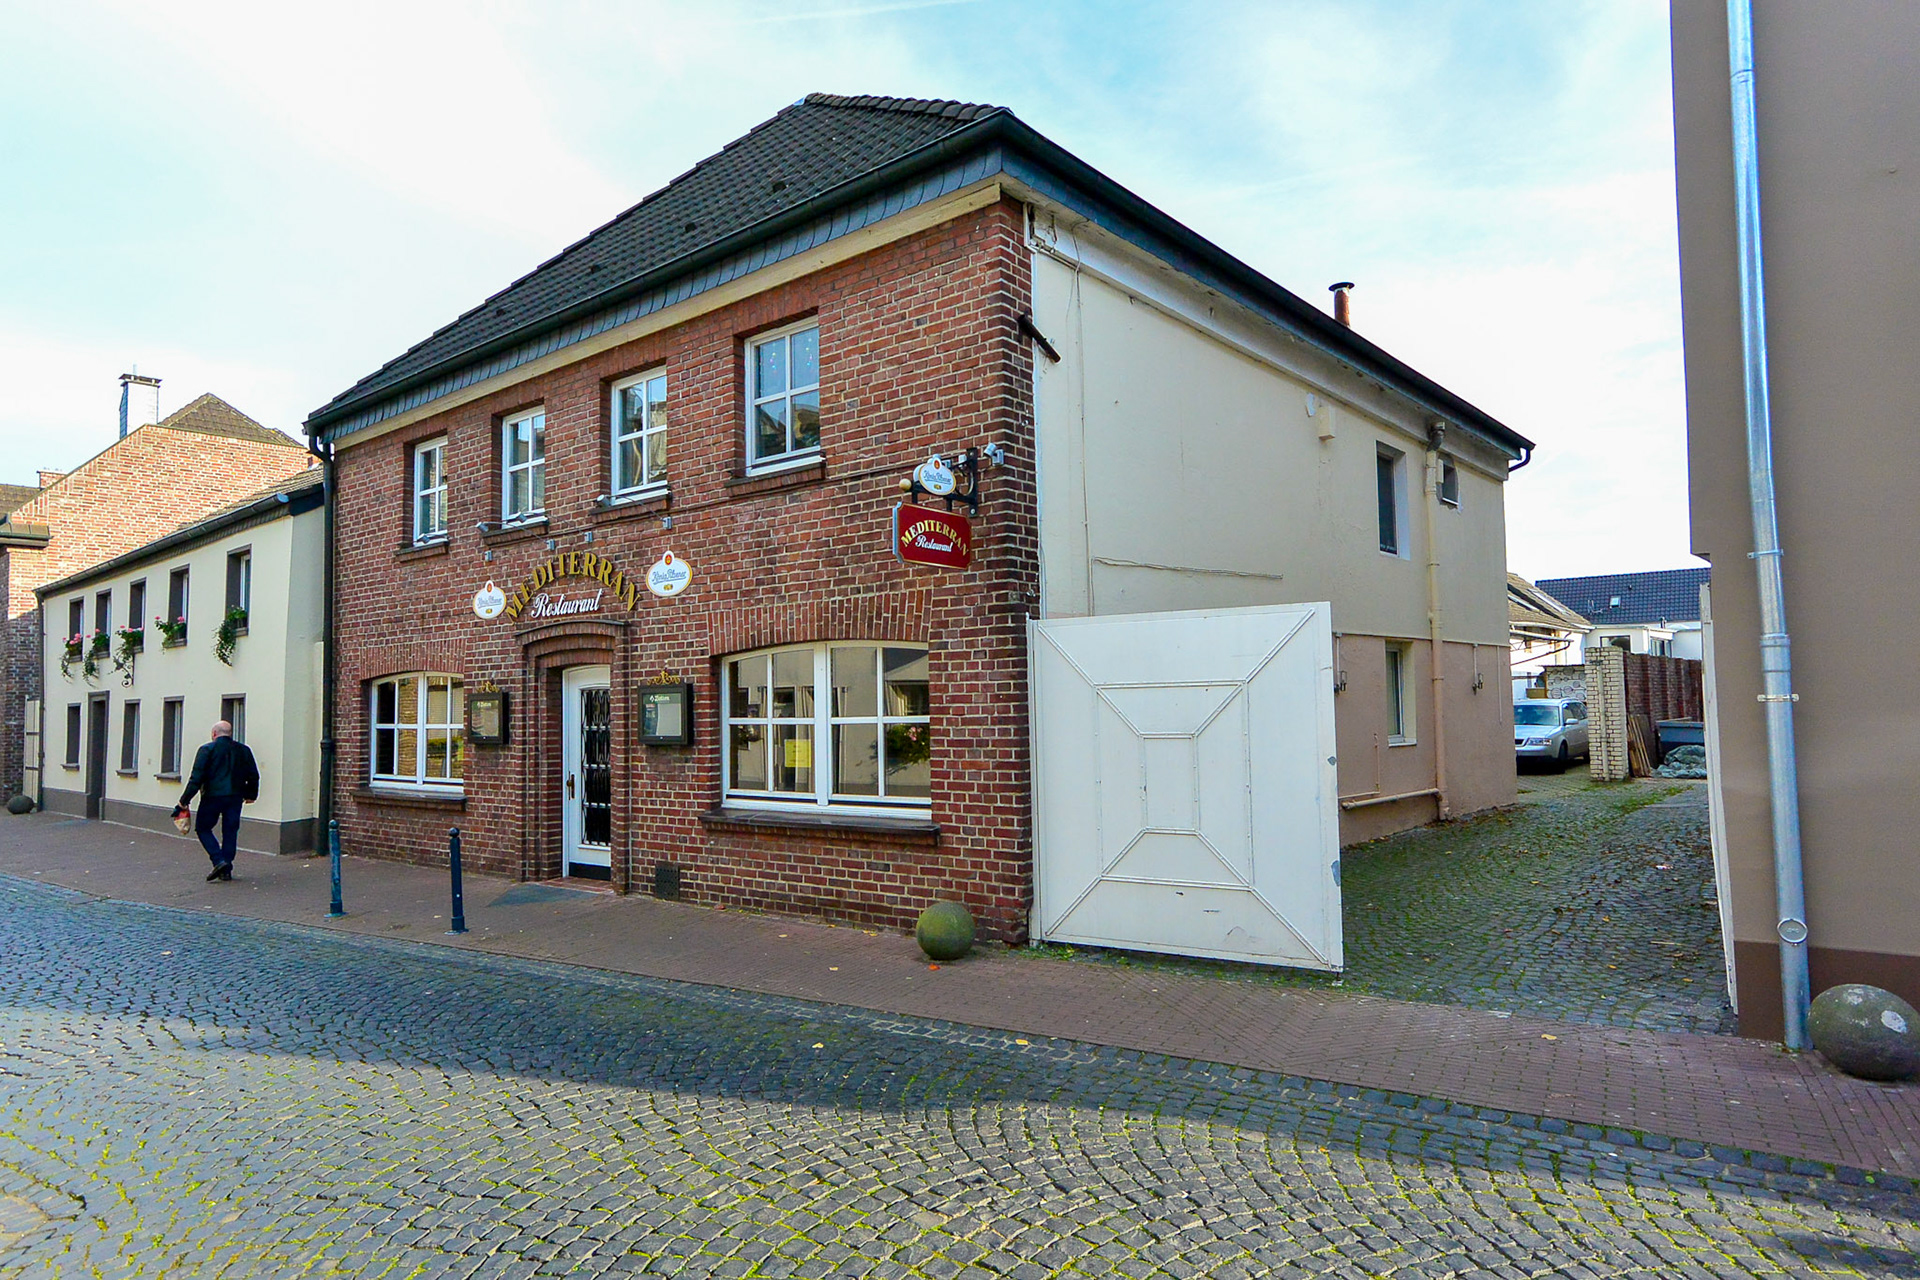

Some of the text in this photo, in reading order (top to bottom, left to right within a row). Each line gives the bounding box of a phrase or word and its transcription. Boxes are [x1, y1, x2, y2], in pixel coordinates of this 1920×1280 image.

[901, 520, 969, 556] MEDITERRAN
[915, 535, 953, 552] Restaurant
[505, 551, 641, 625] MEDITERRAN
[531, 588, 603, 618] Restaurant
